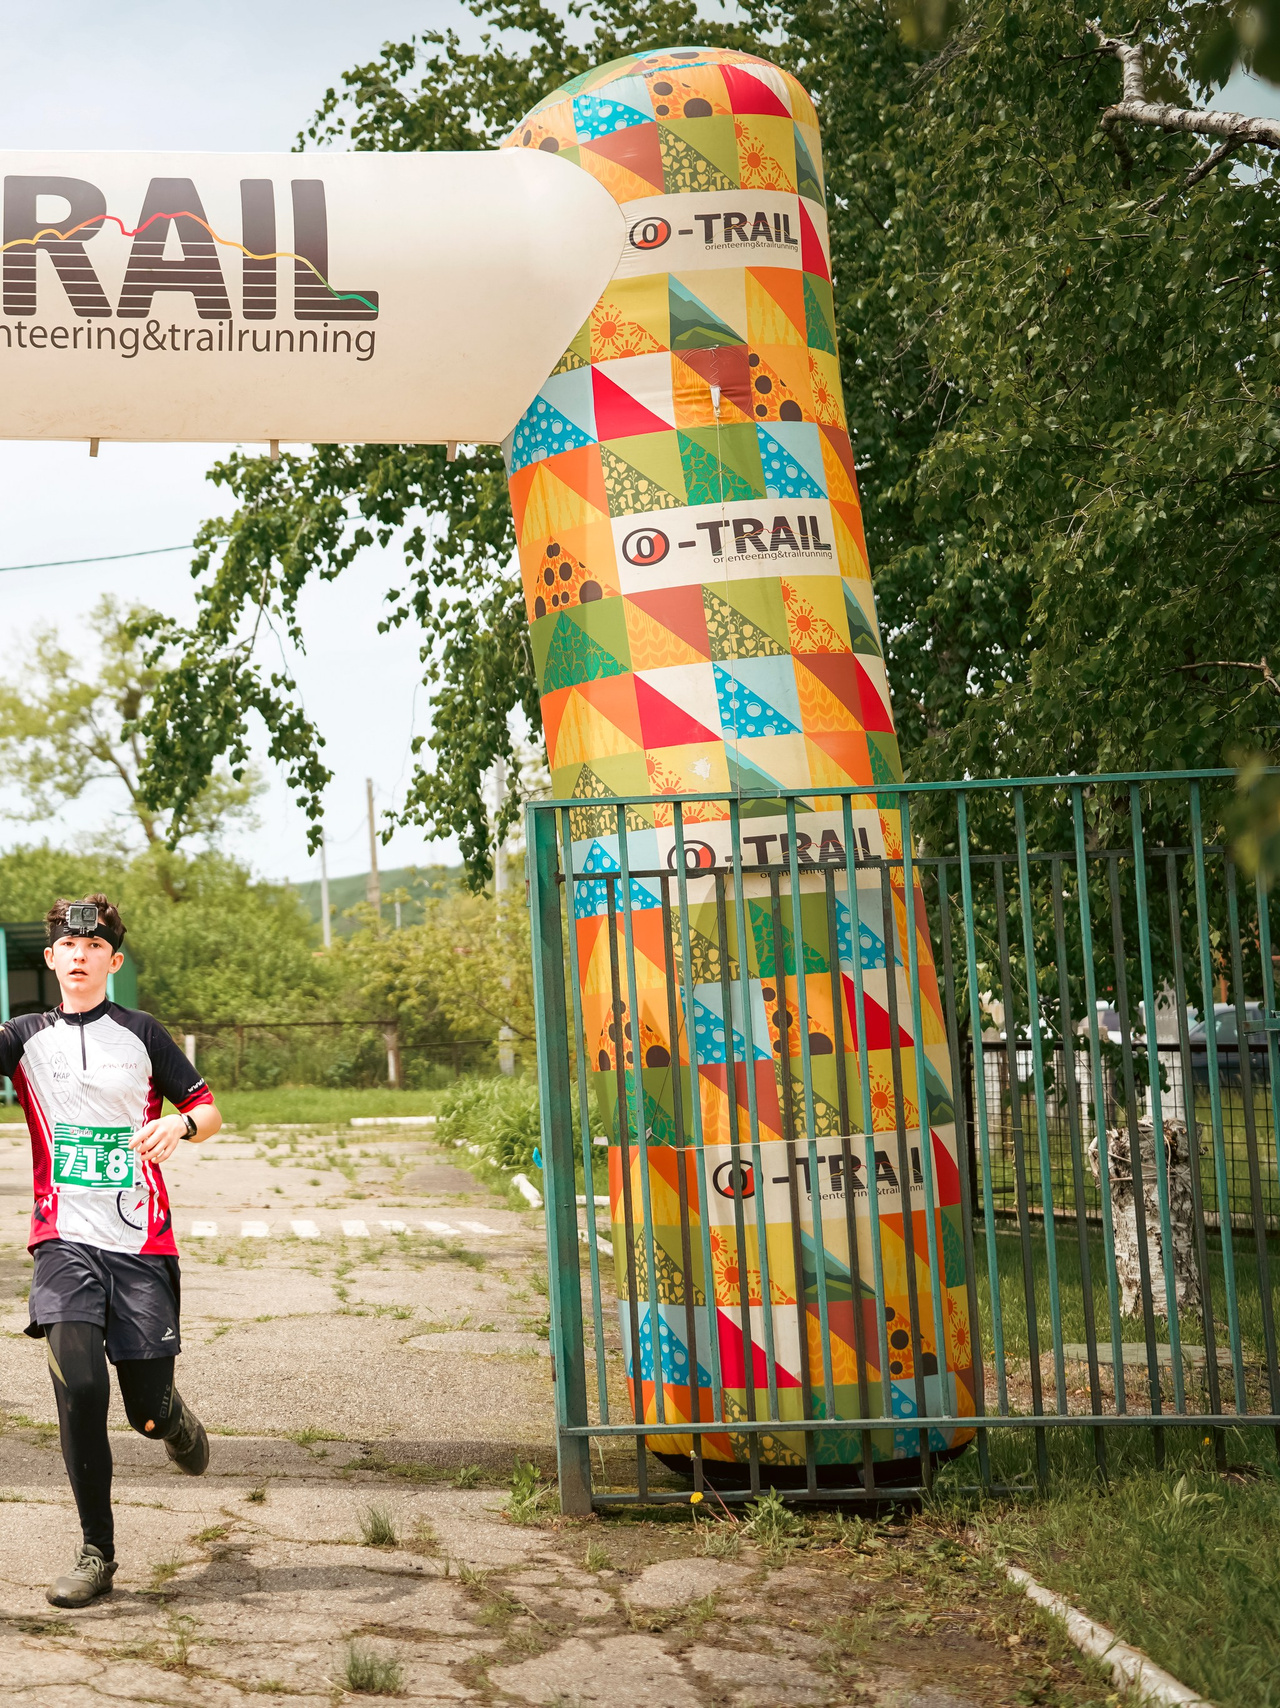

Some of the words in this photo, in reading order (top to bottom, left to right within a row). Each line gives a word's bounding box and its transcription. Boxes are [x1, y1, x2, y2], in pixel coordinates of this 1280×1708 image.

[705, 240, 799, 253] orienteering&trailrunning
[713, 549, 833, 564] orenteering&trailrunning
[60, 1144, 129, 1181] 718
